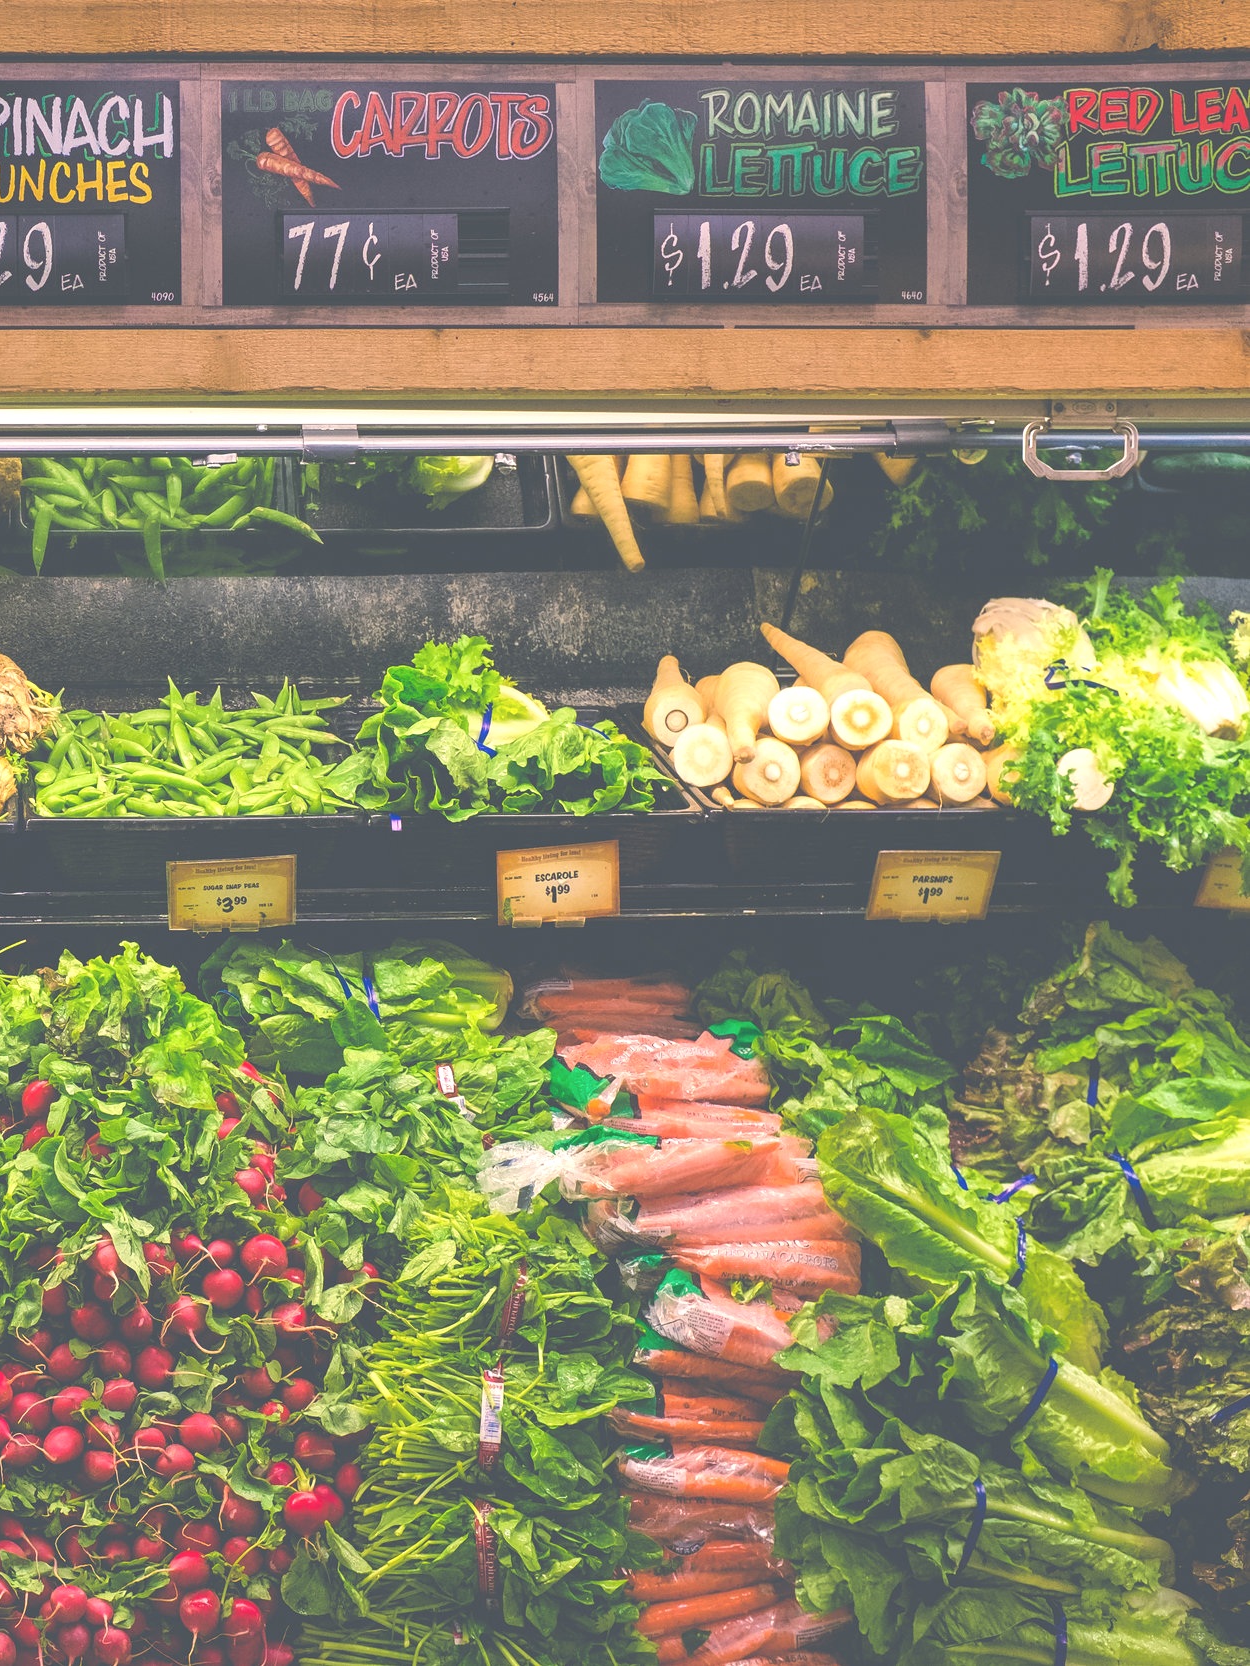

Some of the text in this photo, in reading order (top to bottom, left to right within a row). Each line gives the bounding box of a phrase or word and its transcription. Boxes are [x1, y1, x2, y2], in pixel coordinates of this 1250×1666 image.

[243, 88, 277, 112] LB
[283, 88, 334, 112] BAG
[700, 88, 900, 140] ROMAINE
[1063, 87, 1250, 138] RED LEA
[330, 91, 554, 160] CARROTS
[700, 141, 923, 198] LETTUCE
[1054, 136, 1250, 198] LETTUC
[61, 274, 84, 291] EA
[394, 273, 418, 291] EA
[800, 275, 822, 291] EA
[1176, 273, 1198, 290] EA
[151, 292, 175, 301] 4090
[532, 293, 554, 303] 4564
[901, 291, 923, 301] 4640
[535, 870, 579, 882] ESCAROLE
[912, 875, 954, 884] PARSNIPS
